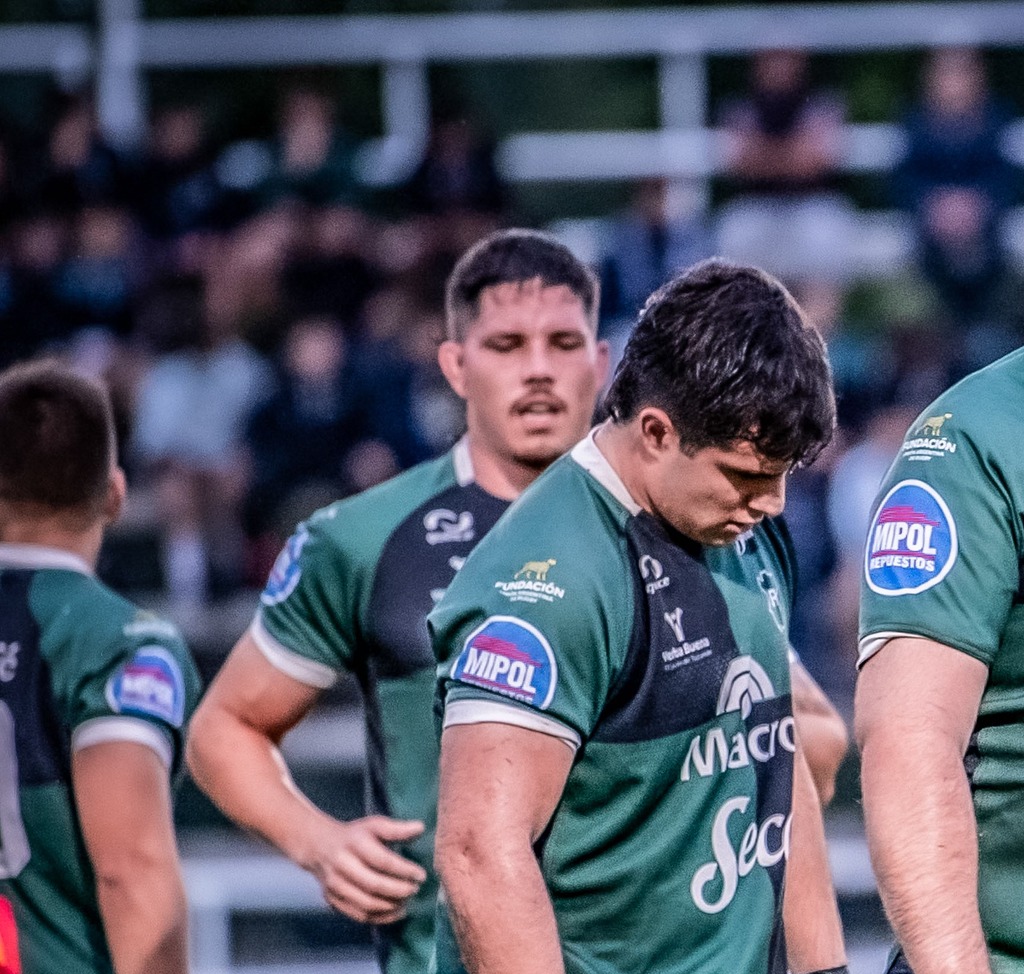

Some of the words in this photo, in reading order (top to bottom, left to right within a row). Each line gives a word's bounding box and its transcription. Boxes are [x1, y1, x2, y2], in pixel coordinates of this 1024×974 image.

[872, 521, 937, 555] MIPOL
[495, 580, 565, 599] FUNDACIÓN
[463, 647, 536, 694] MIPOL
[690, 796, 794, 915] Sec
